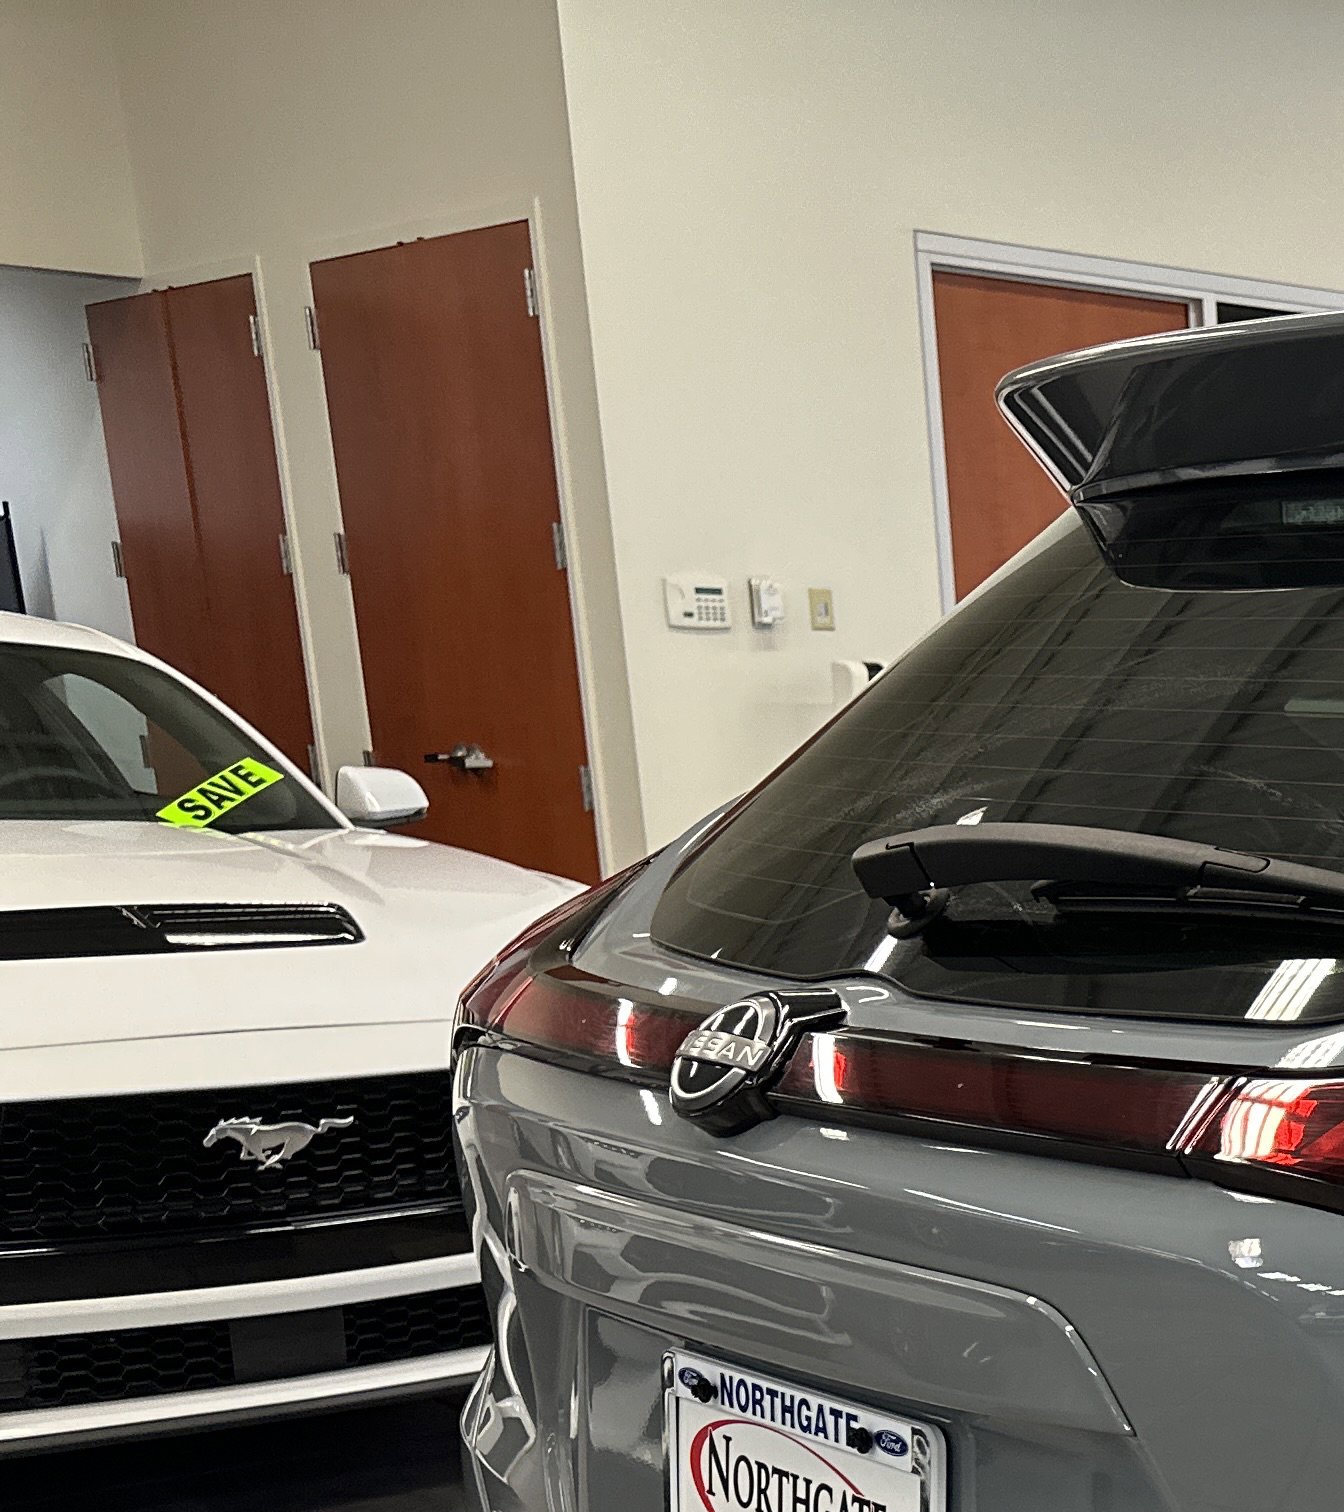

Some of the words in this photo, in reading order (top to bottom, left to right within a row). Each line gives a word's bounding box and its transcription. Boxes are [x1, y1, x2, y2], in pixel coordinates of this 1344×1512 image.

[177, 764, 267, 821] SAVE
[719, 1372, 859, 1447] NORTHGATE
[880, 1431, 902, 1454] Ford
